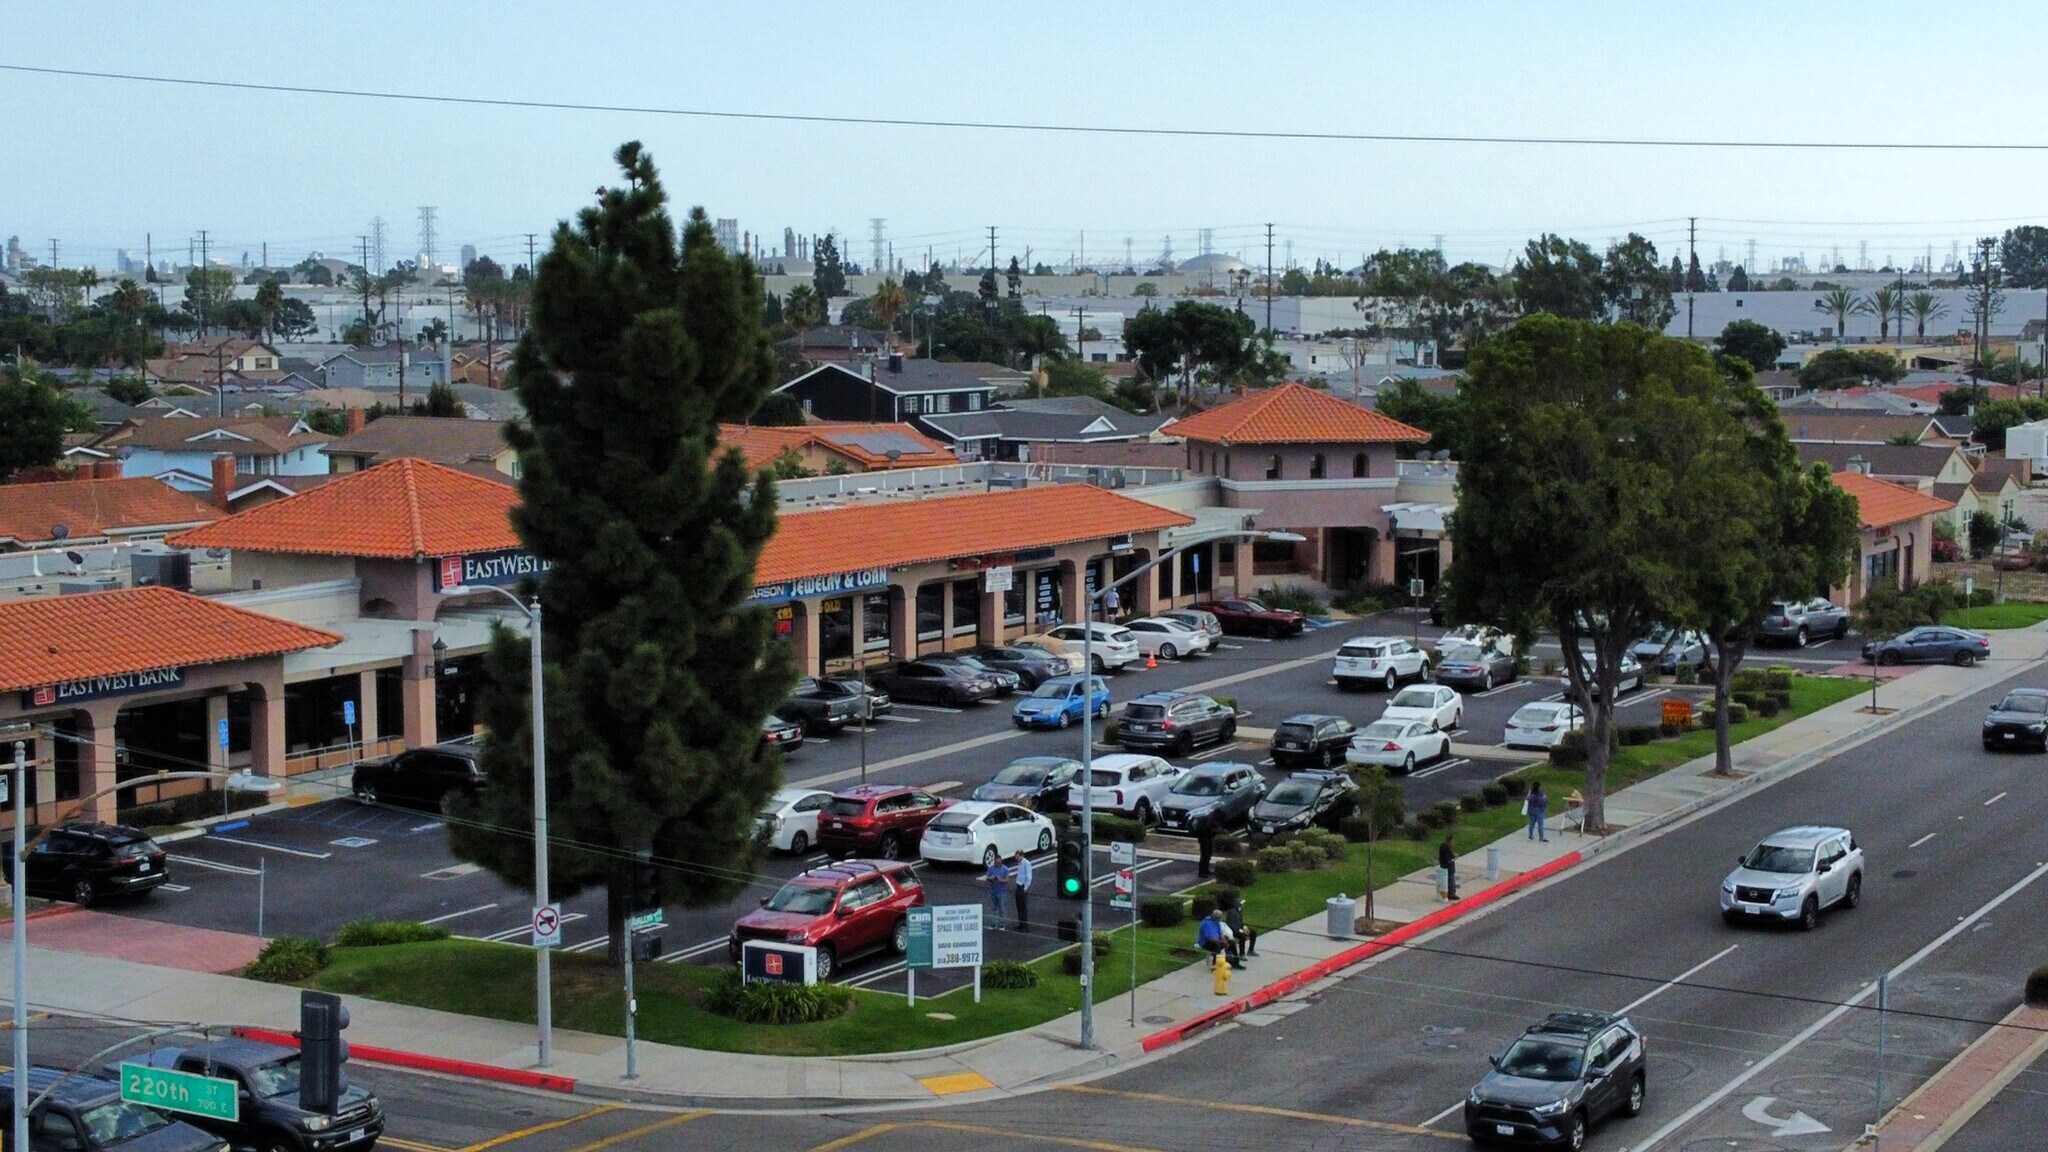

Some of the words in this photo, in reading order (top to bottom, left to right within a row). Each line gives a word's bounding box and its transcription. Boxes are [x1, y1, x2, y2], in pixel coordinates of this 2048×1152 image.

[790, 574, 841, 597] JEWELRY
[843, 573, 854, 589] &
[857, 567, 887, 586] LOAN
[138, 667, 180, 686] BANK
[129, 1074, 189, 1103] 220th
[206, 1085, 218, 1095] ST
[220, 1102, 227, 1113] E
